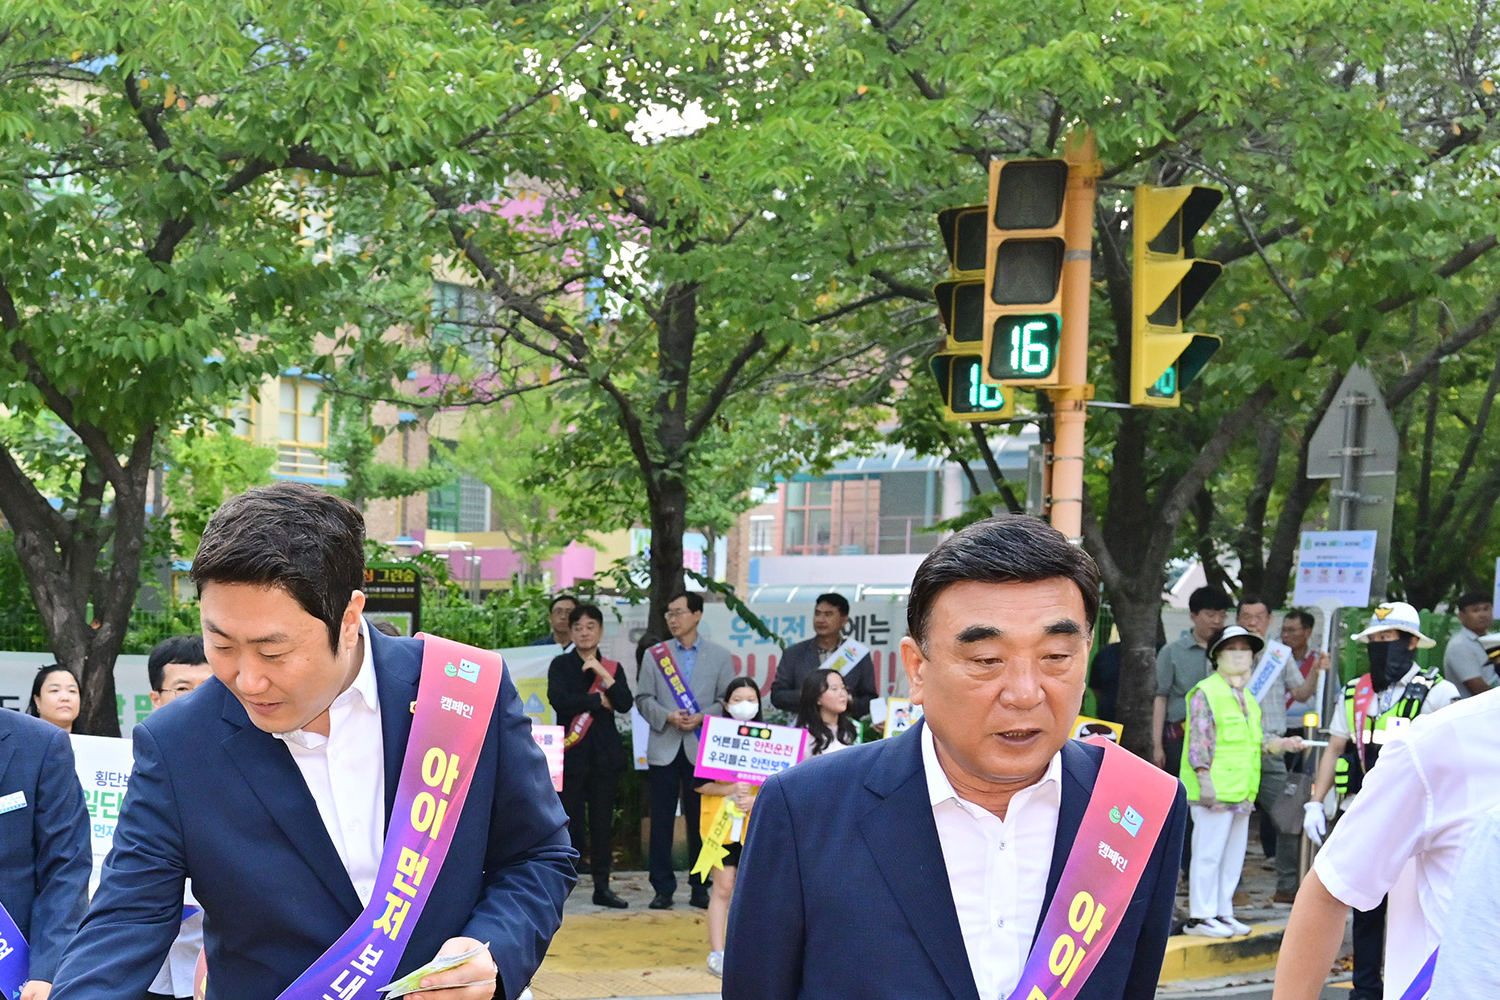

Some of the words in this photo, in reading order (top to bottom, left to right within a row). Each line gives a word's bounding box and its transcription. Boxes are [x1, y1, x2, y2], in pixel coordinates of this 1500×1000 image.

[1010, 321, 1049, 373] 16
[439, 695, 475, 720] 캠페인
[708, 751, 747, 767] 우리들은
[712, 734, 750, 751] 어른들은
[754, 740, 793, 757] 안전운전
[409, 746, 460, 841] 아이
[1097, 840, 1129, 873] 캠페인
[373, 846, 430, 942] 먼저
[1048, 890, 1107, 988] 아이
